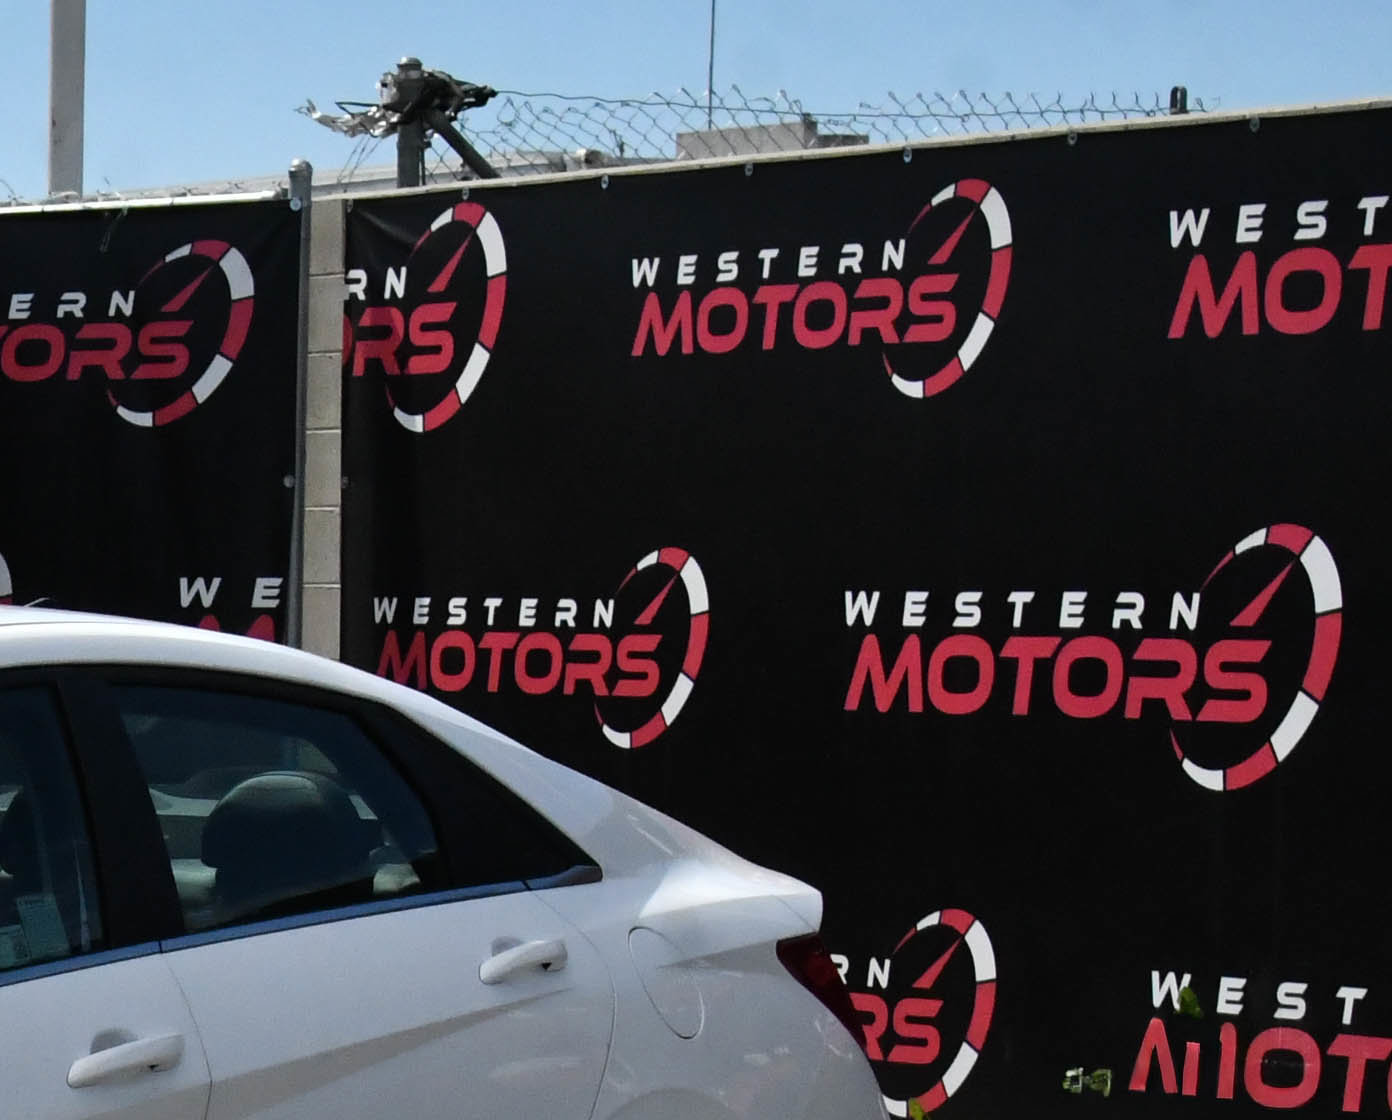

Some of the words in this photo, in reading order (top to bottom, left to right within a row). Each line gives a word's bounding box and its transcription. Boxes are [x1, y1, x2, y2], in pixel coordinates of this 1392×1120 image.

[1170, 196, 1389, 248] WEST
[632, 239, 905, 288] WESTERN
[1168, 243, 1392, 339] MOT
[342, 302, 457, 376] RS
[632, 273, 959, 356] MOTORS
[180, 578, 282, 607] WE
[374, 597, 614, 628] WESTERN
[845, 591, 1200, 630] WESTERN
[376, 630, 663, 697] MOTORS
[844, 634, 1272, 723] MOTORS
[1152, 971, 1367, 1025] WEST
[1128, 1017, 1392, 1112] MOT
